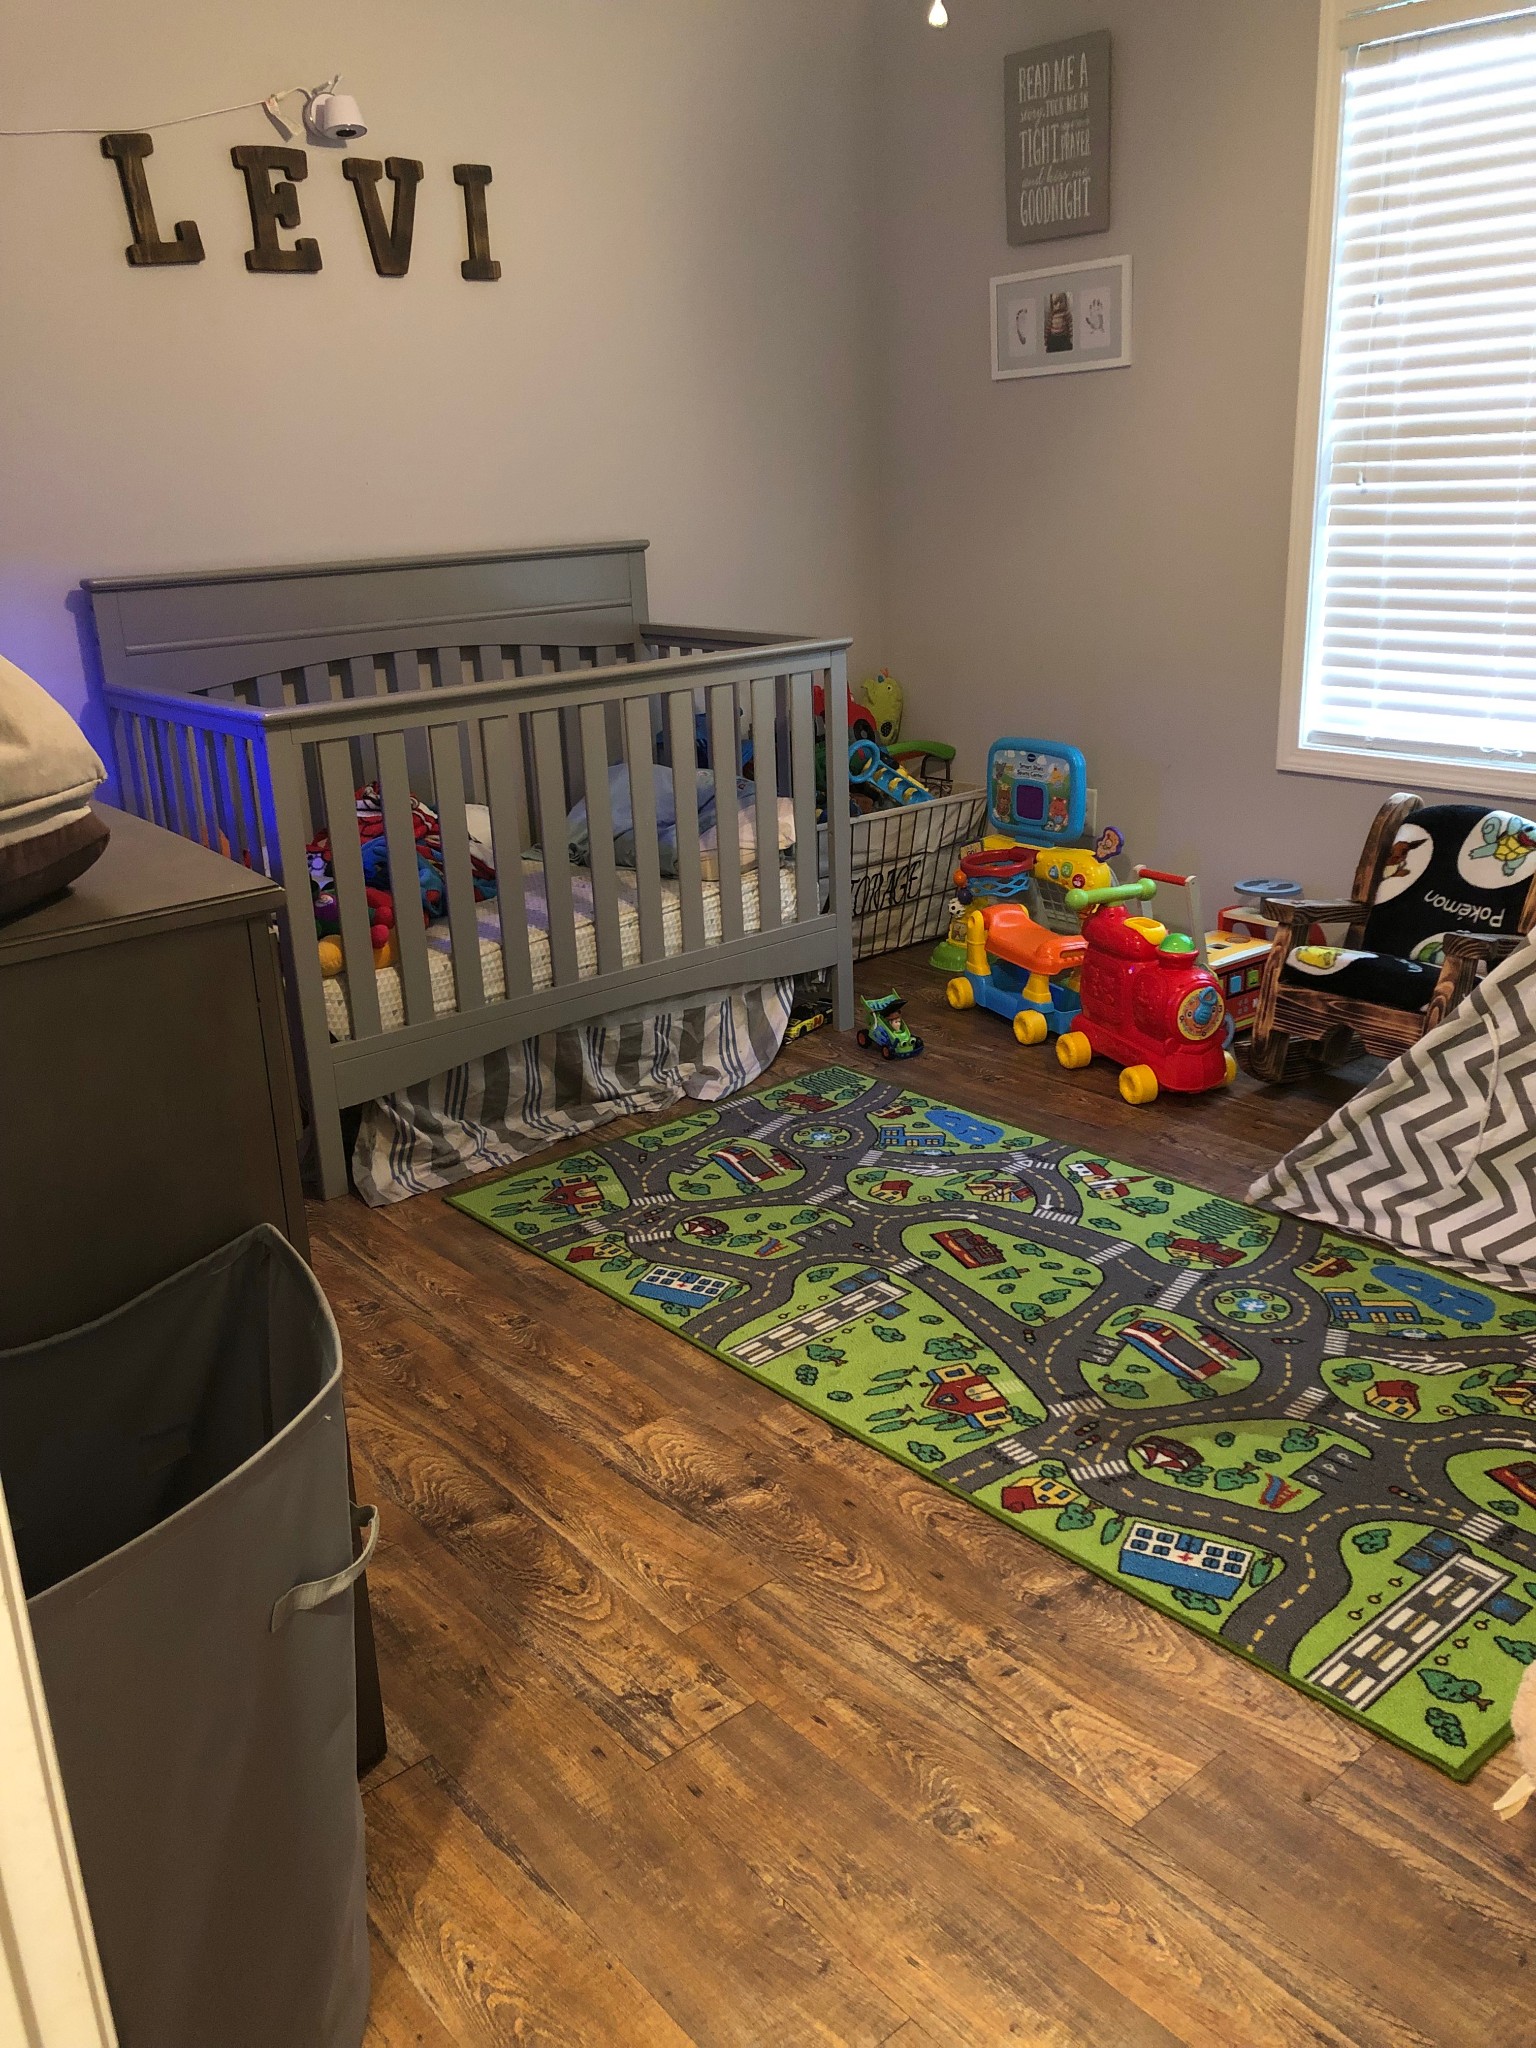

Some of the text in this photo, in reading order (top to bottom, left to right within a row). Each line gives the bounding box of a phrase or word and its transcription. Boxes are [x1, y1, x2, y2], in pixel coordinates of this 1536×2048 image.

[1019, 52, 1089, 102] READ ME A
[1067, 94, 1078, 112] ME
[1080, 91, 1089, 110] IN
[1071, 167, 1089, 178] me
[101, 132, 501, 281] LEVI
[851, 860, 921, 915] ORAGE
[1424, 889, 1506, 928] Pokémon
[1307, 1452, 1353, 1485] P P P
